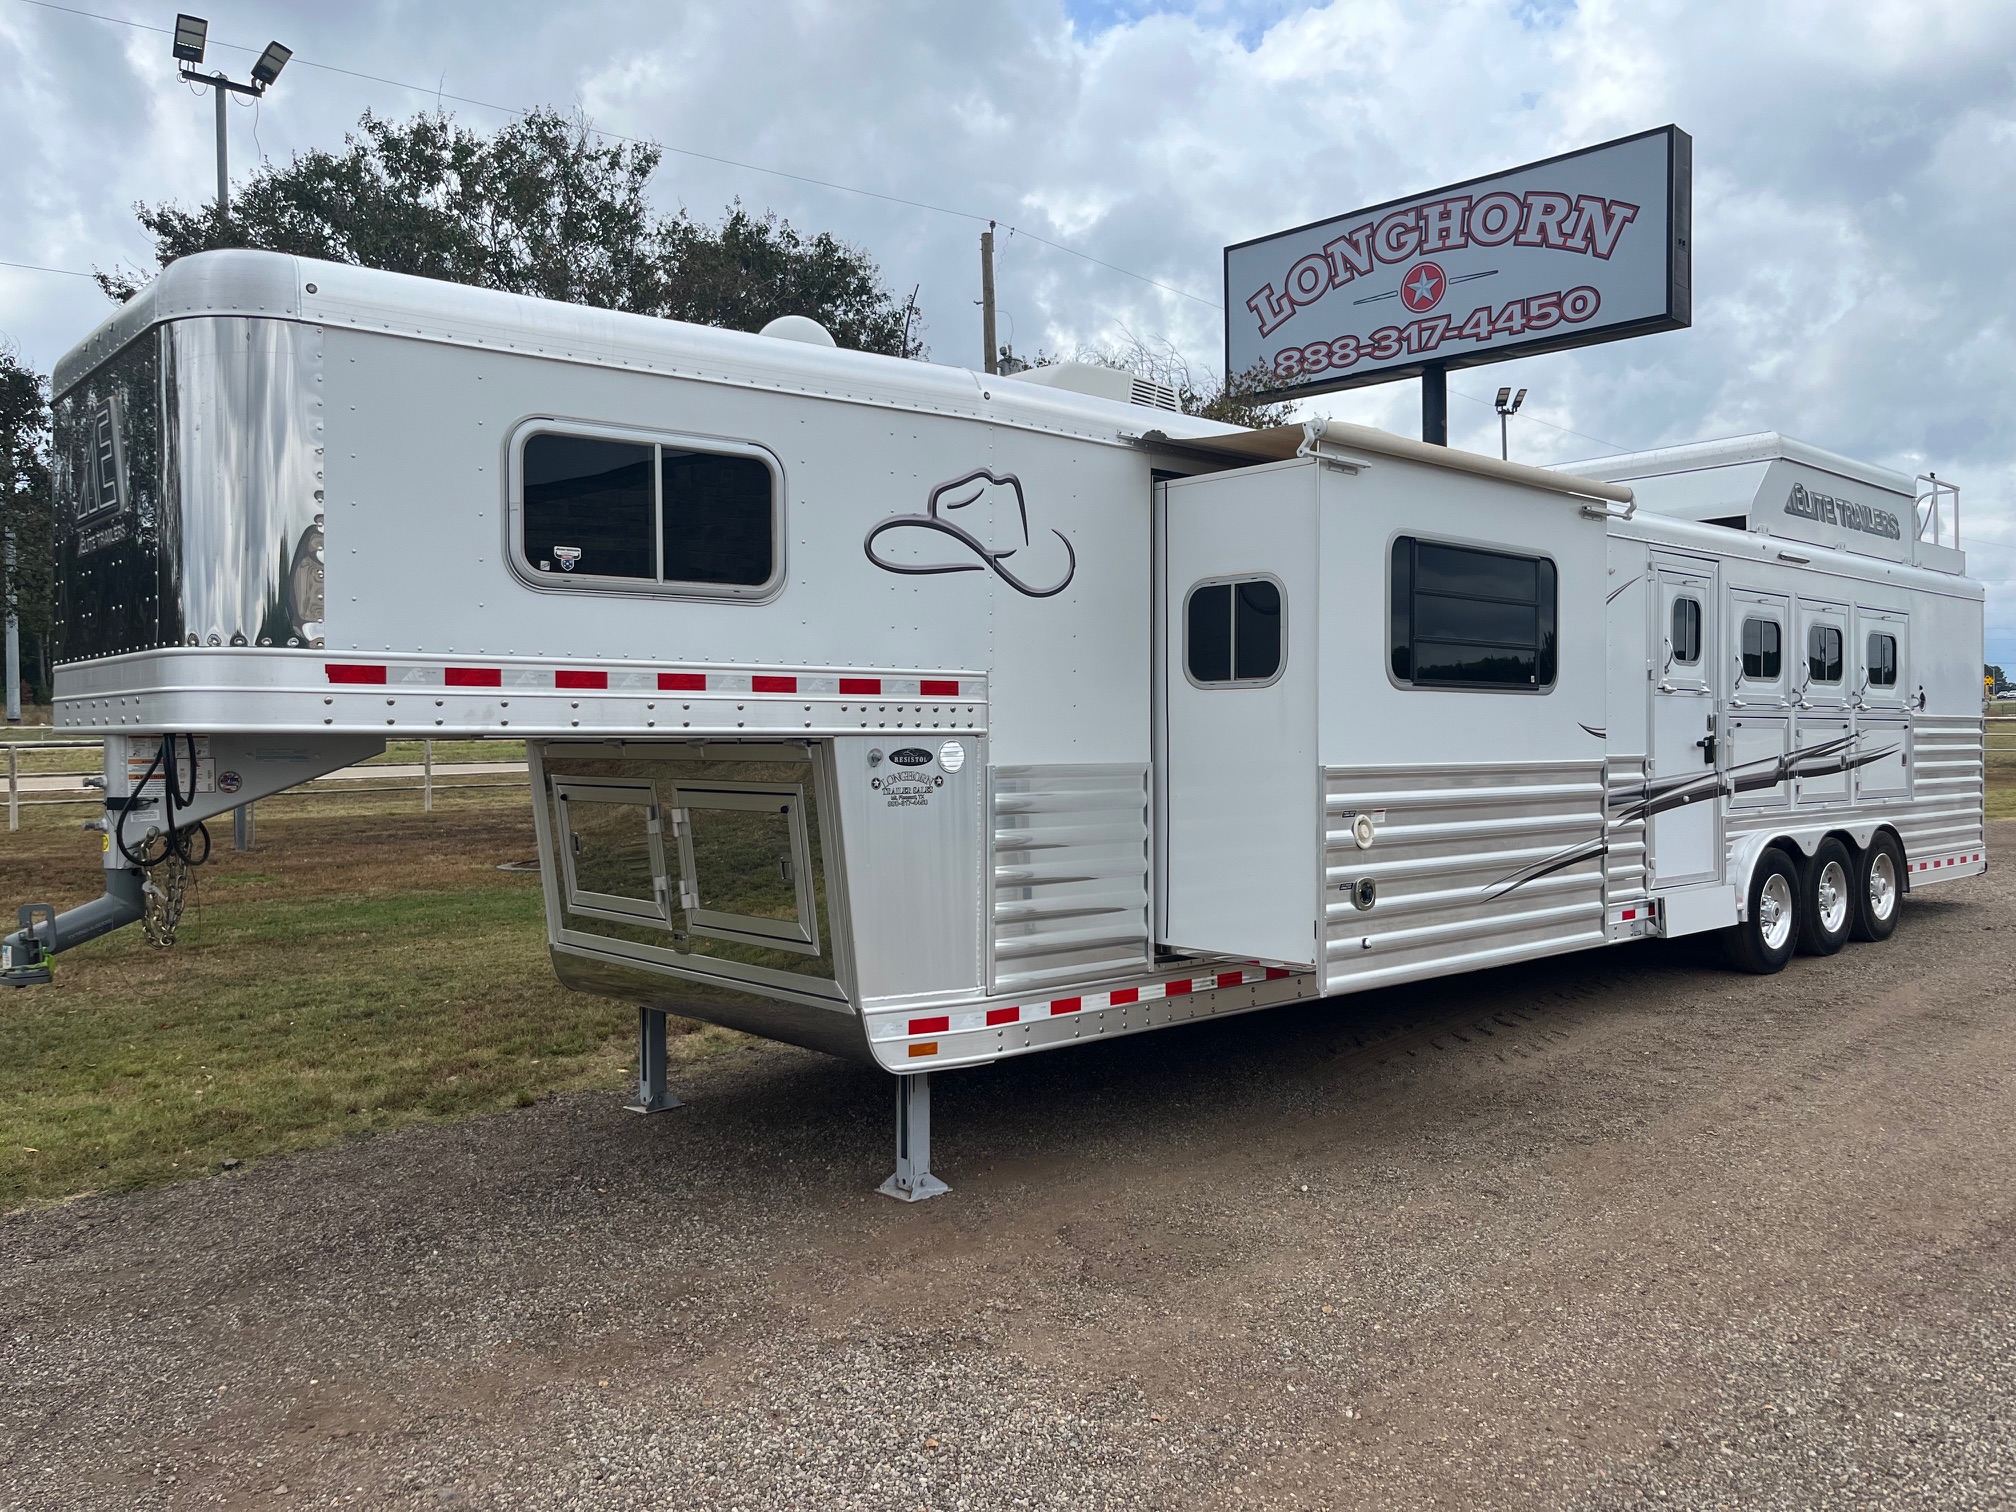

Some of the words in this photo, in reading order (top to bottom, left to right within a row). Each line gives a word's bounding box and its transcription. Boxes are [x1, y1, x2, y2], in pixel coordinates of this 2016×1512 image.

[1246, 191, 1641, 338] LONGHORN
[1274, 286, 1601, 380] 888-317-4450
[1784, 482, 1837, 525] ELITE
[1836, 498, 1900, 540] TRAILERS
[881, 771, 935, 790] LONGHORN
[882, 787, 912, 795] TRAILER
[913, 786, 934, 794] SALES
